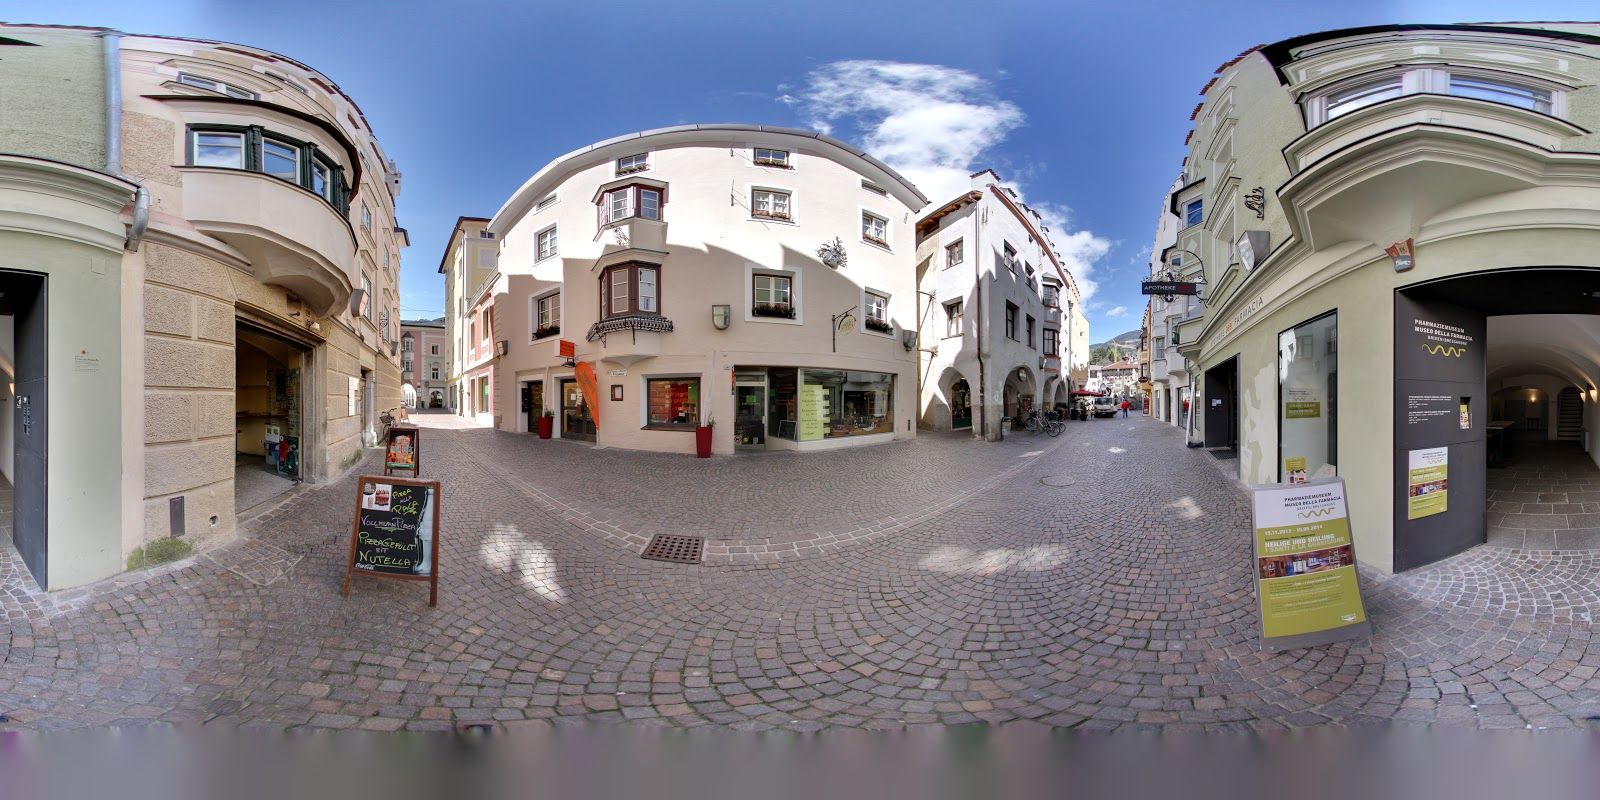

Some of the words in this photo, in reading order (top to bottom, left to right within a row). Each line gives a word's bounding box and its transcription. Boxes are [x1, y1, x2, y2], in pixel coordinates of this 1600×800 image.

[1234, 296, 1264, 325] FARMACIA
[1414, 319, 1465, 334] PHARMAZIEMUSEUM
[1414, 326, 1434, 334] MUSEO
[1434, 329, 1450, 337] DELLA
[1450, 332, 1473, 341] FARMACIA
[1284, 492, 1332, 502] PHARMAZIEMUSEUM
[1264, 540, 1291, 548] HEILIGE
[1307, 534, 1335, 543] HEILUNG
[359, 550, 411, 566] NUTELLA
